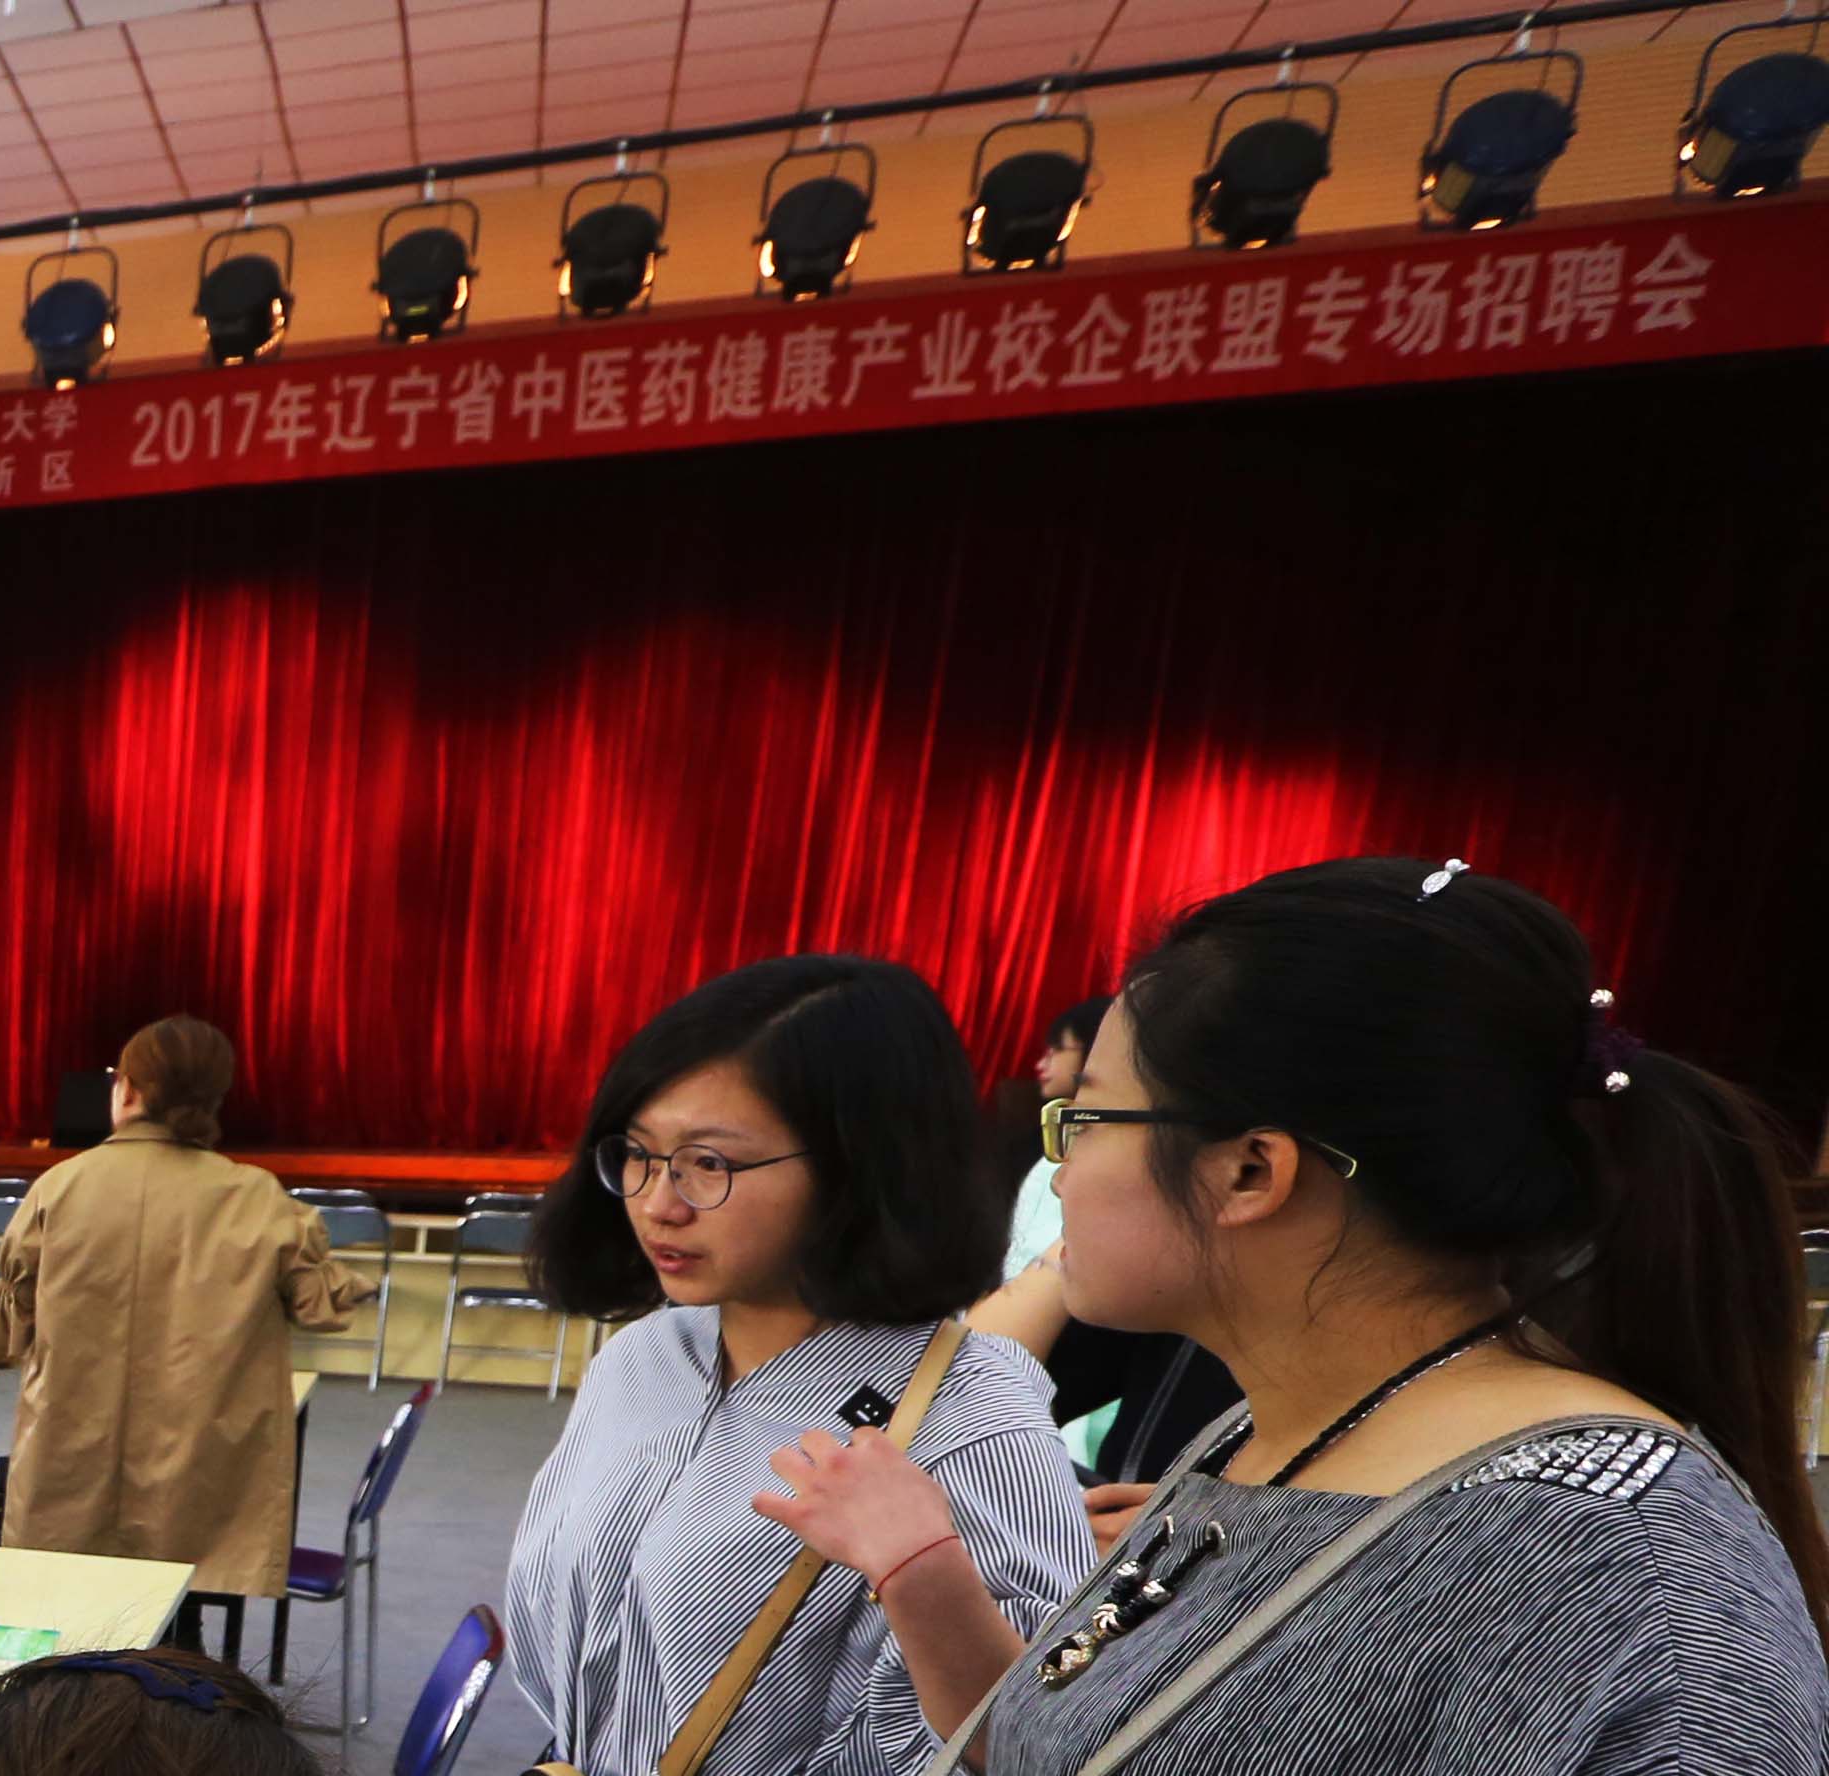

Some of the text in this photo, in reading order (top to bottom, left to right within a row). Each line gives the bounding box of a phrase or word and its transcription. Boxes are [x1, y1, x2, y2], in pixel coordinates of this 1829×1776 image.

[130, 232, 1715, 468] 2017年辽宁省中医药健康产业校企联盟专场招聘会
